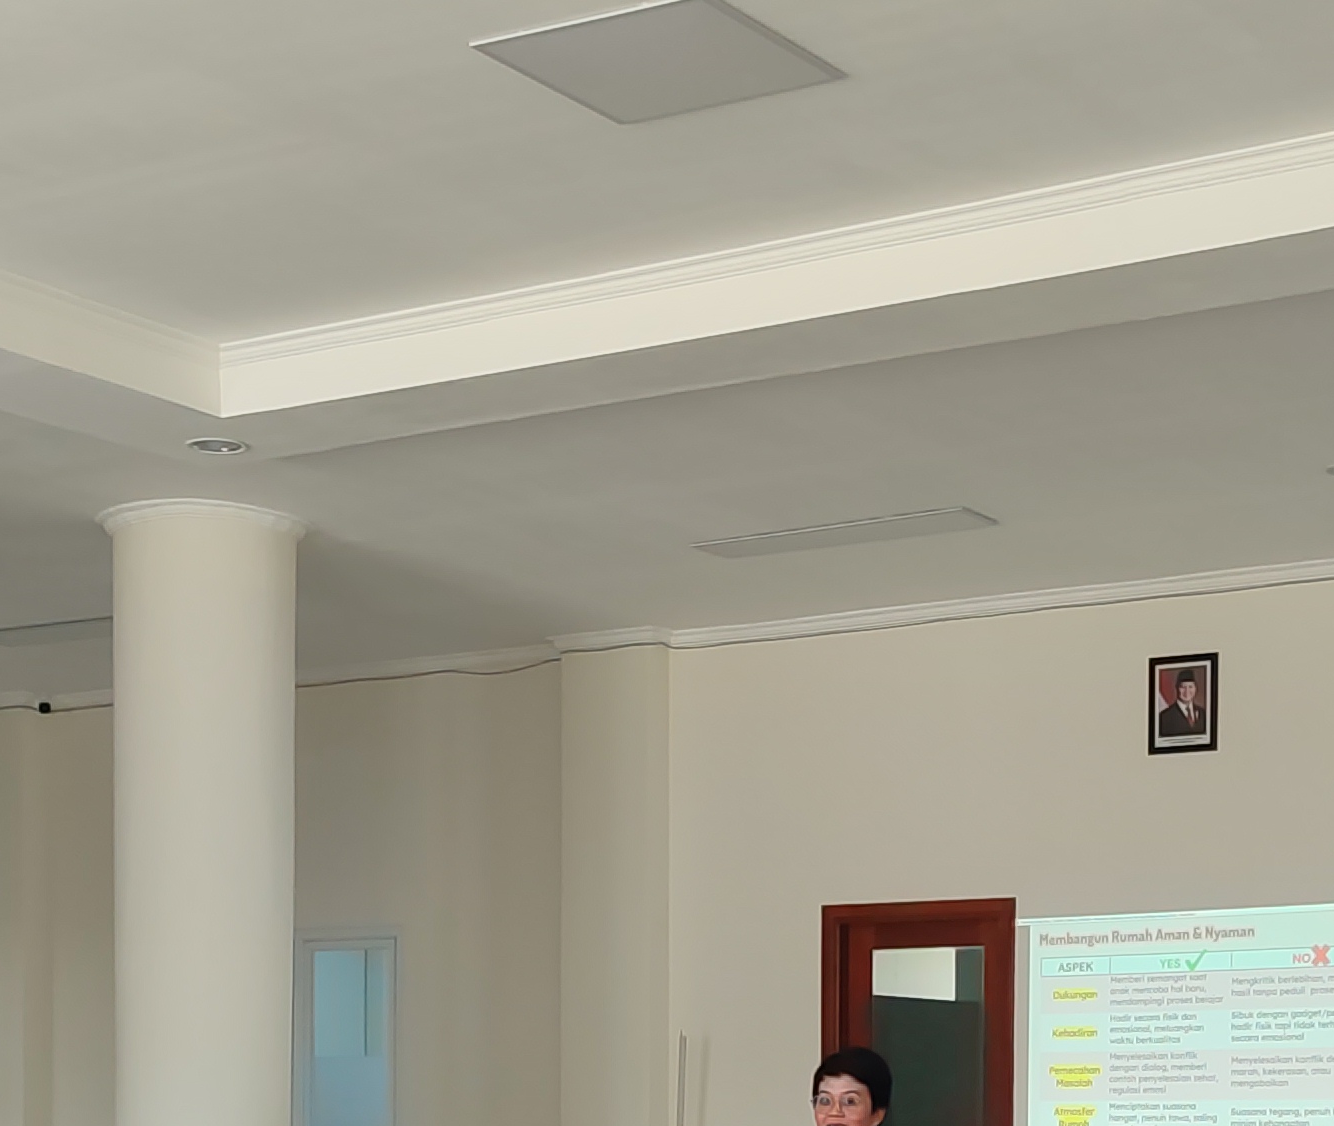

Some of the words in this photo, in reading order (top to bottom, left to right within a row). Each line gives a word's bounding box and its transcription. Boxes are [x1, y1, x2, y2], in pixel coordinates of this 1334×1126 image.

[1039, 933, 1109, 946] Membangun
[1112, 929, 1152, 942] Rumah
[1155, 929, 1189, 941] Aman
[1193, 927, 1202, 938] &
[1205, 926, 1255, 941] Nyaman
[1159, 958, 1181, 968] YES
[1292, 953, 1311, 964] NO
[1058, 962, 1093, 972] ASPEK
[1053, 991, 1097, 1000] Dukungan
[1256, 1011, 1288, 1019] dengan
[1109, 1064, 1139, 1073] dengan
[1231, 1108, 1266, 1116] Suasana
